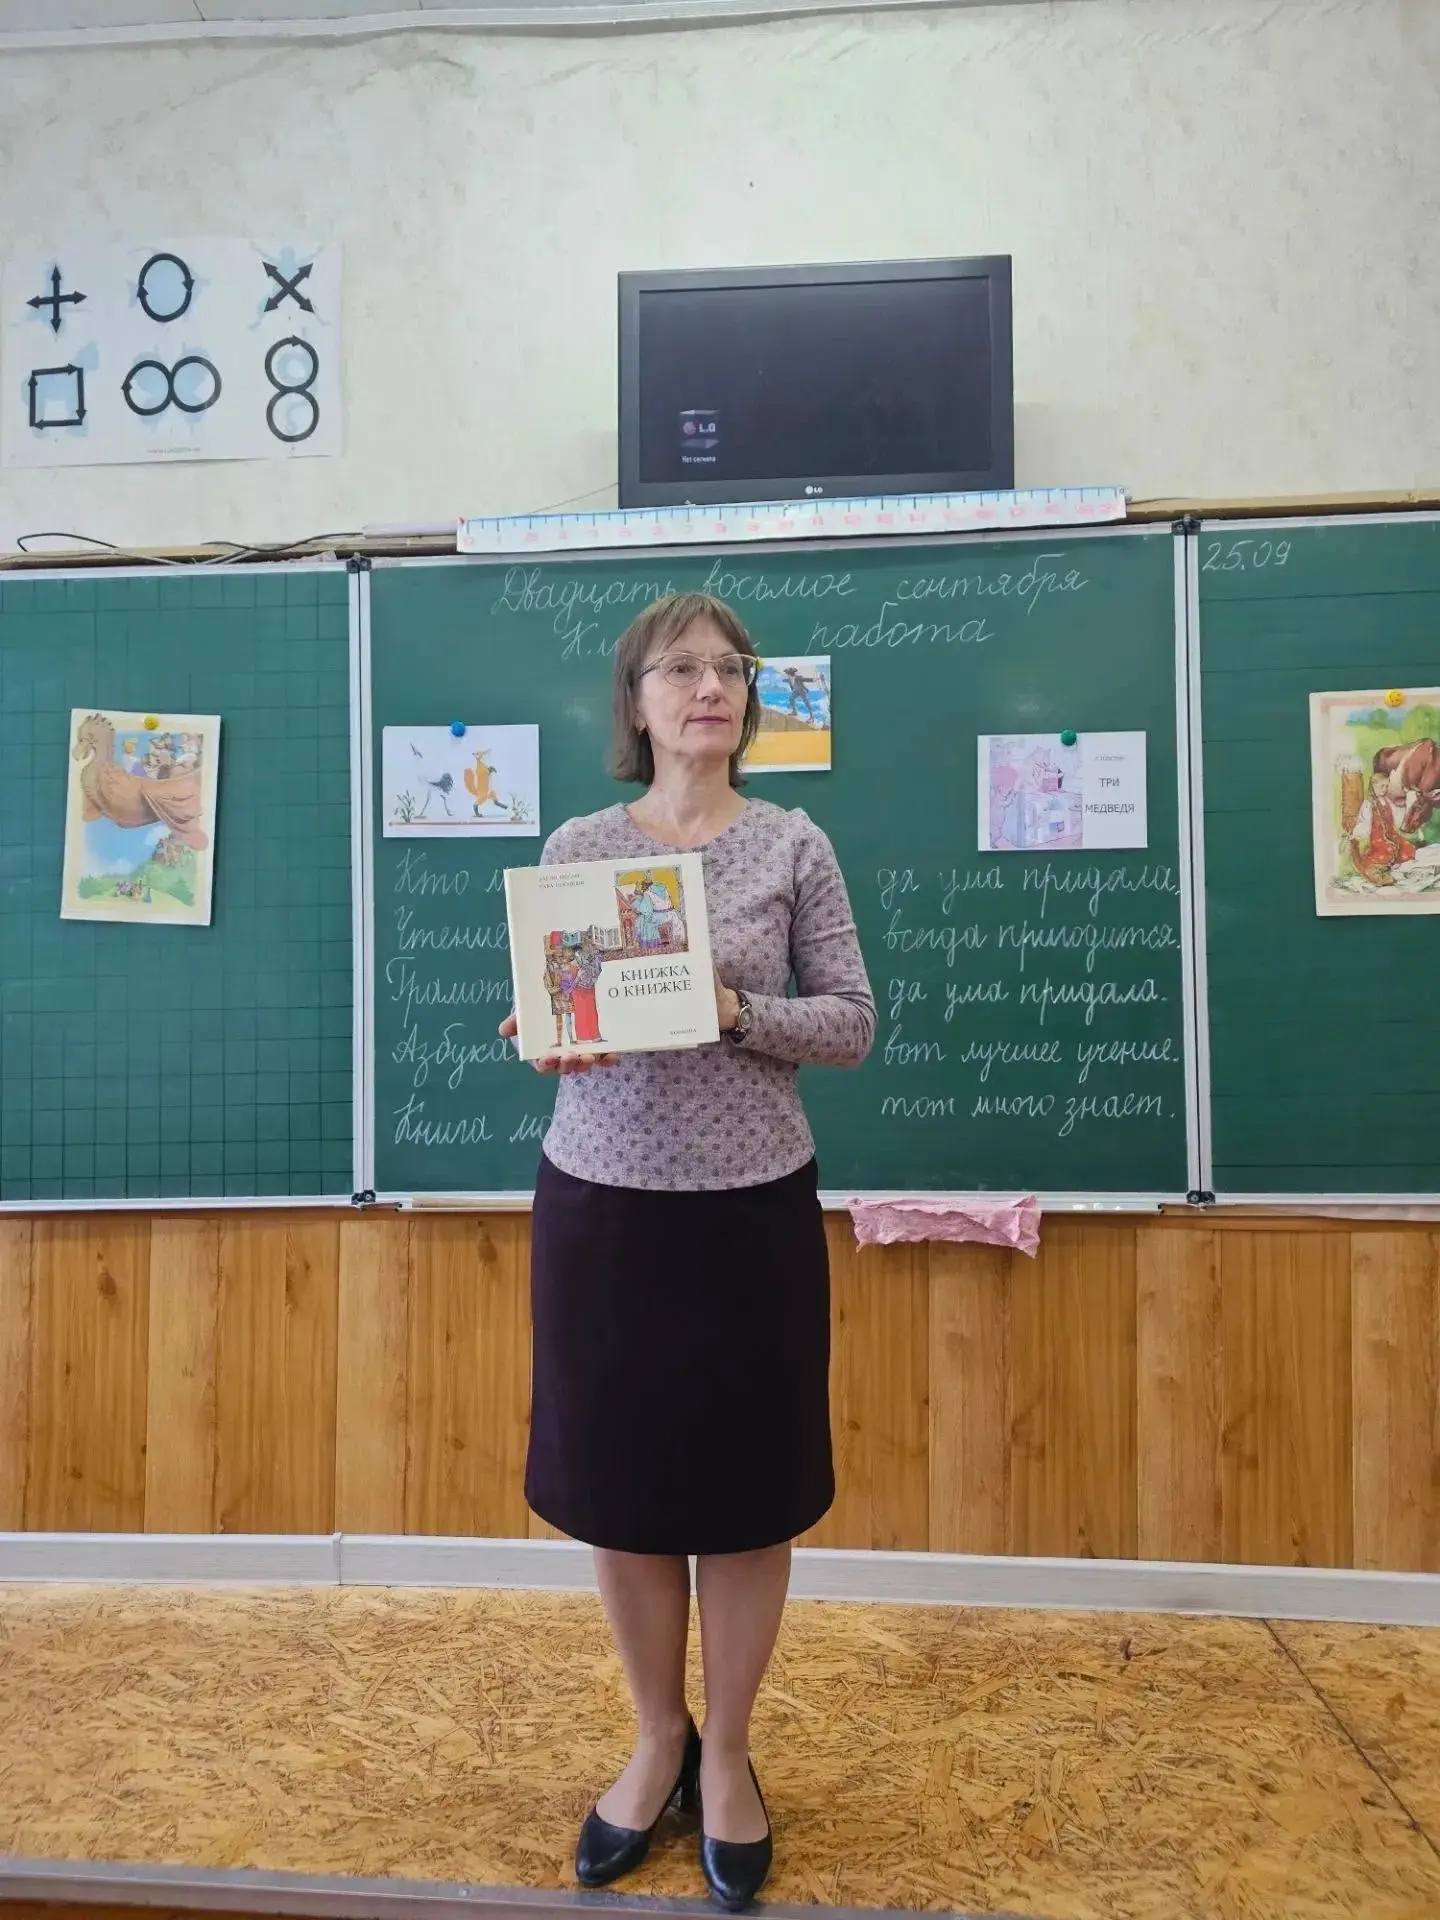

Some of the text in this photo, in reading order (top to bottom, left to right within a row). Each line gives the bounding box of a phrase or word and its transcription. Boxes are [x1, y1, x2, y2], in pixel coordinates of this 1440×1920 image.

[699, 422, 716, 433] LG
[1202, 540, 1291, 571] 25.09
[491, 552, 1091, 634] Двадцать восьмое сентября
[804, 601, 996, 656] работа
[1099, 777, 1120, 787] ТРИ
[1085, 803, 1135, 814] МЕДВЕДЯ
[394, 848, 470, 896] Кто
[877, 866, 920, 910] да
[938, 866, 1005, 915] ума
[394, 905, 509, 951] Чтение
[882, 908, 1182, 972] всегда пригодится.
[386, 957, 514, 1029] Грамот
[608, 979, 692, 998] О КНИЖКЕ
[621, 964, 691, 981] КНИЖКА
[888, 977, 1168, 1026] да ума придала.
[392, 1023, 516, 1090] Азбука
[884, 1023, 1181, 1084] вот лучшее учение.
[394, 1092, 494, 1146] Книга
[881, 1092, 1176, 1137] тот много знает.
